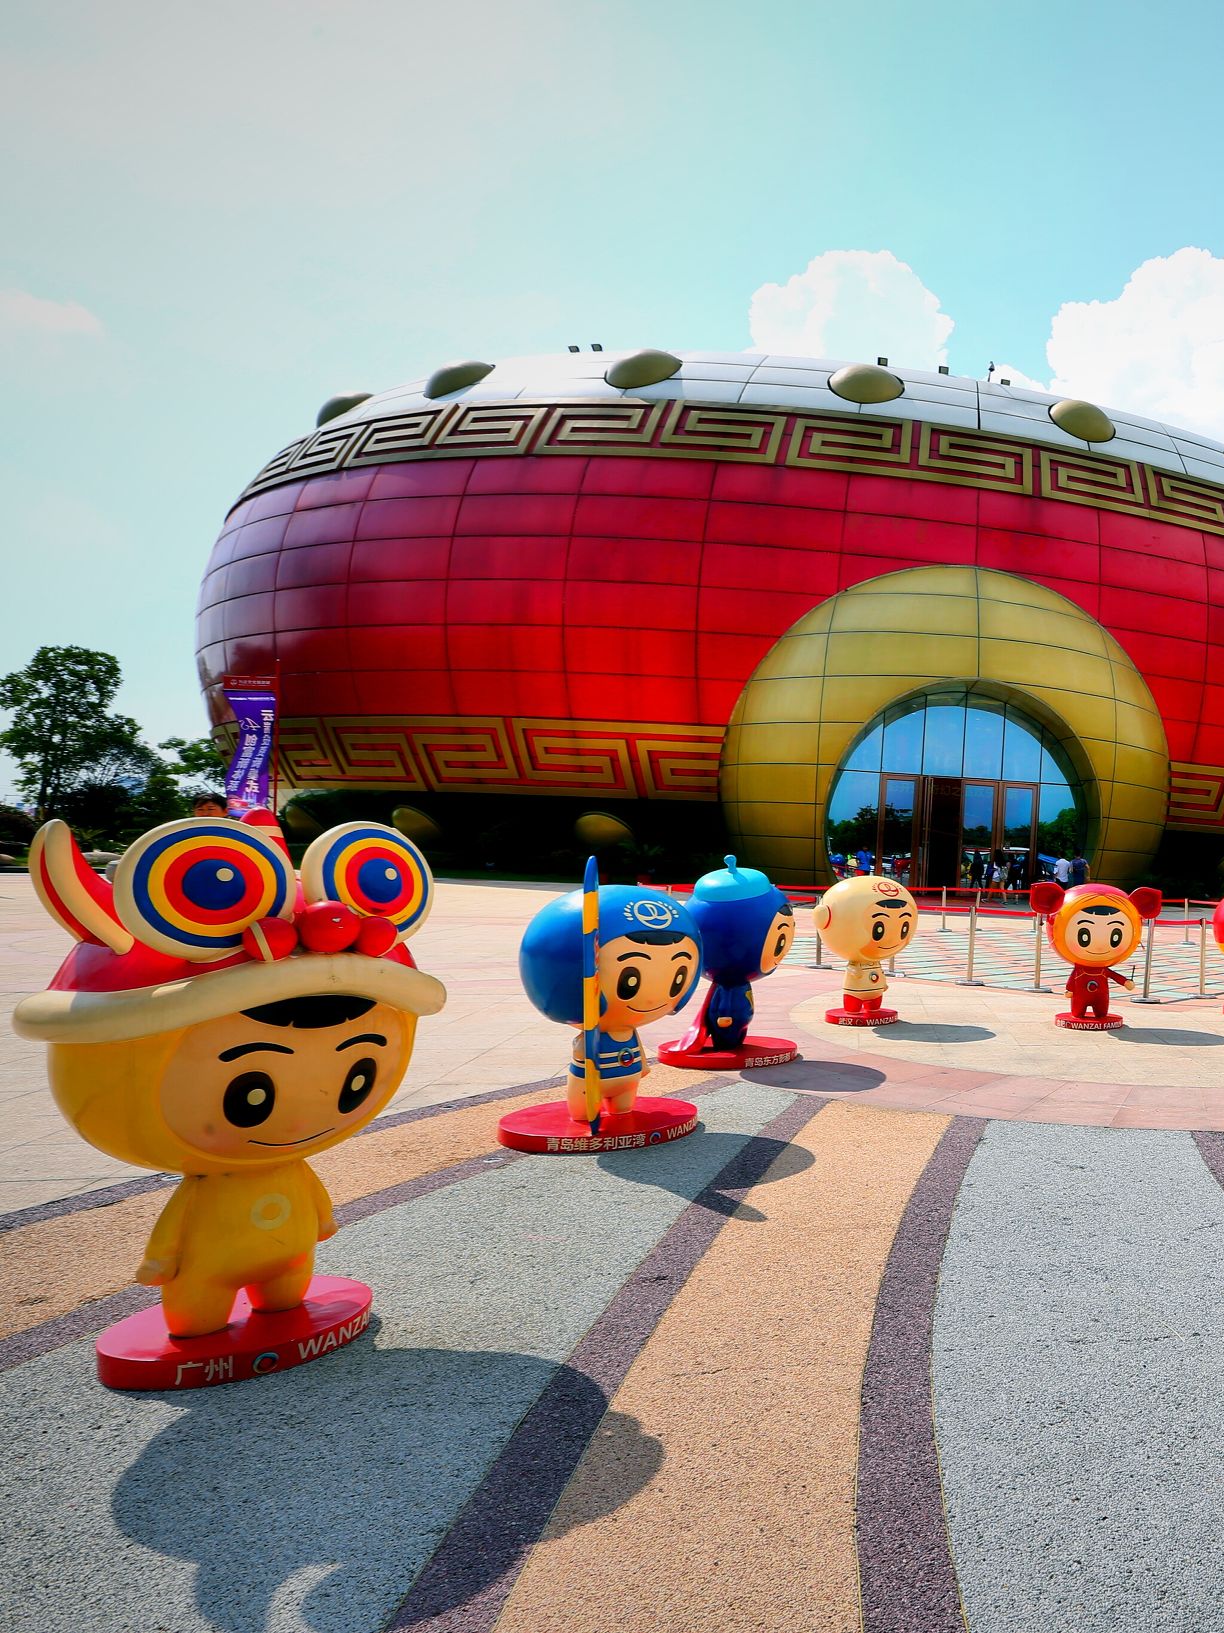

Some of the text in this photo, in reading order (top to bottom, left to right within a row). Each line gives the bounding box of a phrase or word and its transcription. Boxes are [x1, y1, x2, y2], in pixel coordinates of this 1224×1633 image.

[1071, 1022, 1103, 1030] WANZAI
[546, 1133, 647, 1152] 青岛维多利亚湾
[174, 1355, 234, 1386] 广州
